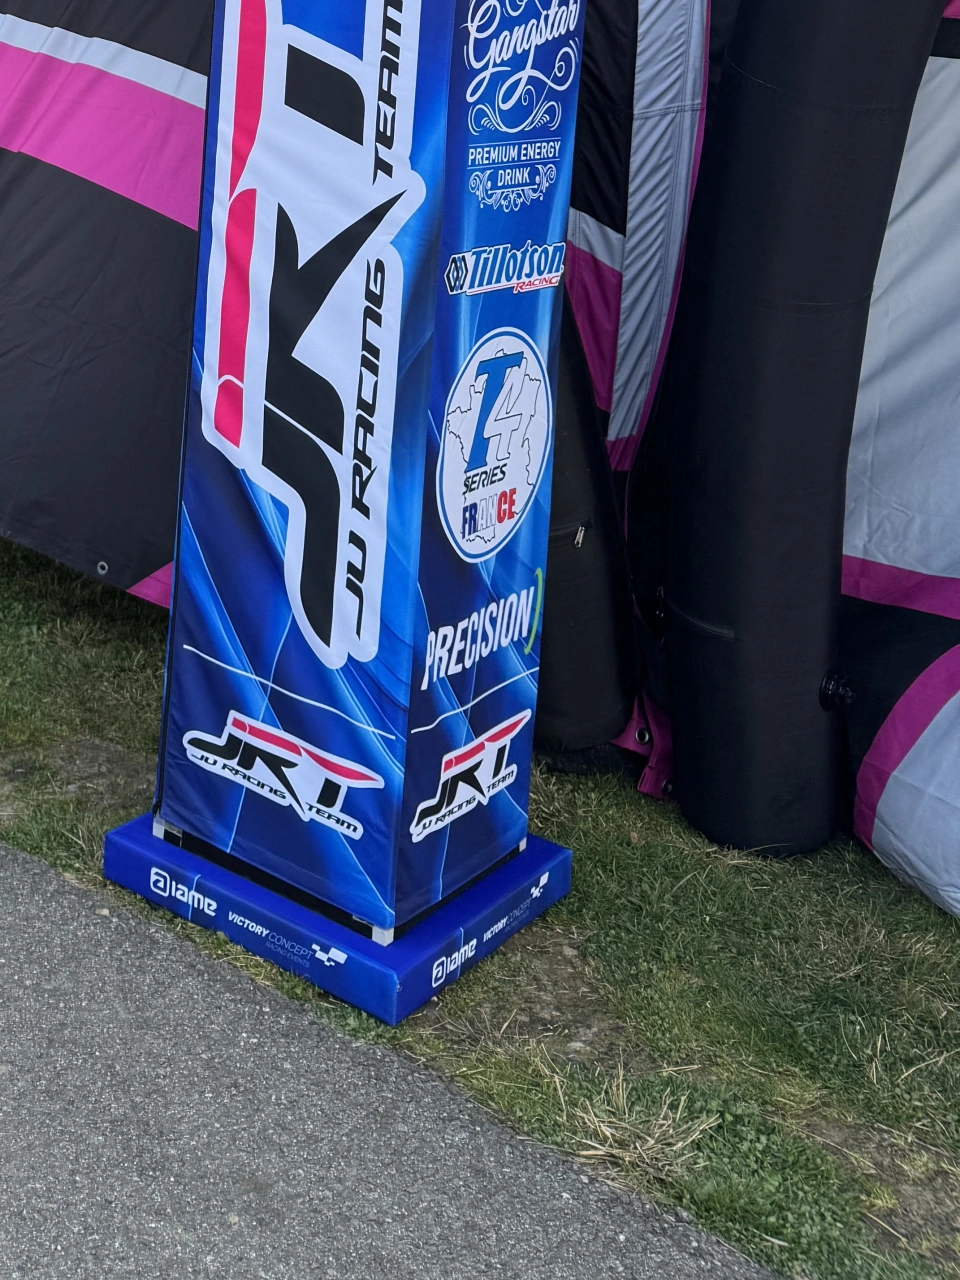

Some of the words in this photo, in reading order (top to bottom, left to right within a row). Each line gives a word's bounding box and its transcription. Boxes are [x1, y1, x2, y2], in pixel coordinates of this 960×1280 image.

[468, 143, 519, 166] PREMIUM
[520, 140, 561, 160] ENERGY
[497, 166, 530, 186] DRINK
[469, 239, 565, 290] Tillotson
[514, 274, 560, 294] RACING
[350, 256, 387, 520] RACING
[464, 351, 525, 473] T4
[462, 463, 508, 496] SERIES
[461, 487, 516, 540] FRANCE
[345, 530, 368, 641] JU
[420, 586, 534, 691] PRECISION
[186, 717, 382, 816] JRT
[417, 715, 530, 818] JRT
[191, 753, 218, 768] JU
[220, 762, 287, 801] RACING
[305, 802, 360, 835] TEAM
[434, 794, 477, 823] RACING
[486, 770, 515, 795] TEAM
[228, 910, 271, 938] VICTORY
[268, 932, 313, 960] CONCEPT
[265, 941, 287, 957] RACING
[286, 952, 310, 969] EVENTS
[483, 915, 508, 942] VICTORY
